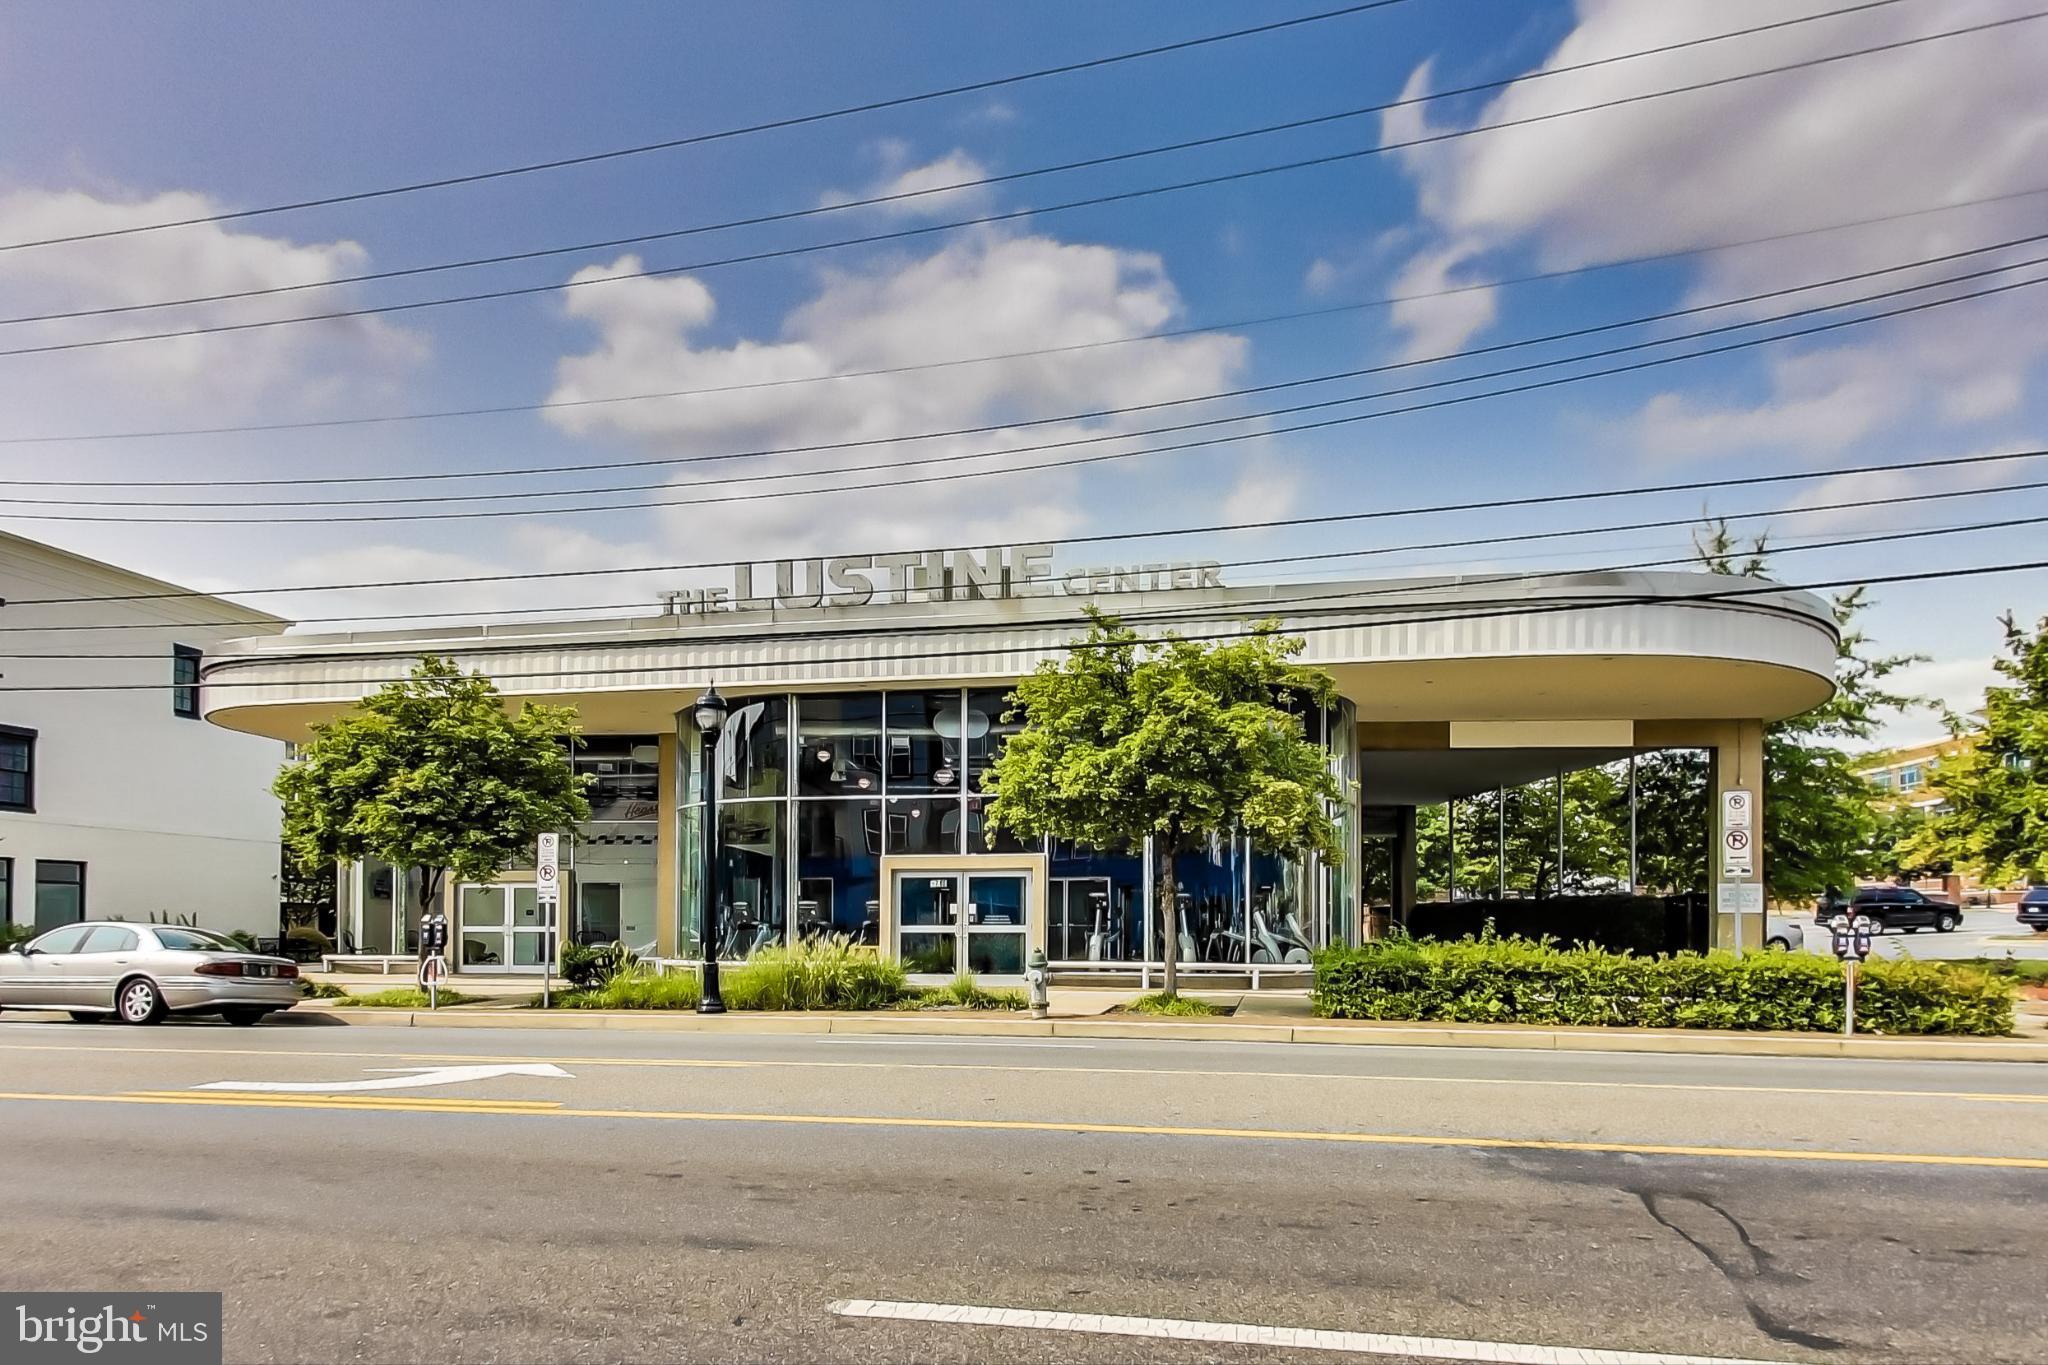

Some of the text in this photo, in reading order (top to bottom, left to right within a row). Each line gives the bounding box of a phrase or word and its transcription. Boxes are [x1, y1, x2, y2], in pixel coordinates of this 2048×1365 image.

[656, 545, 1224, 616] THE LUSTINE CENTER
